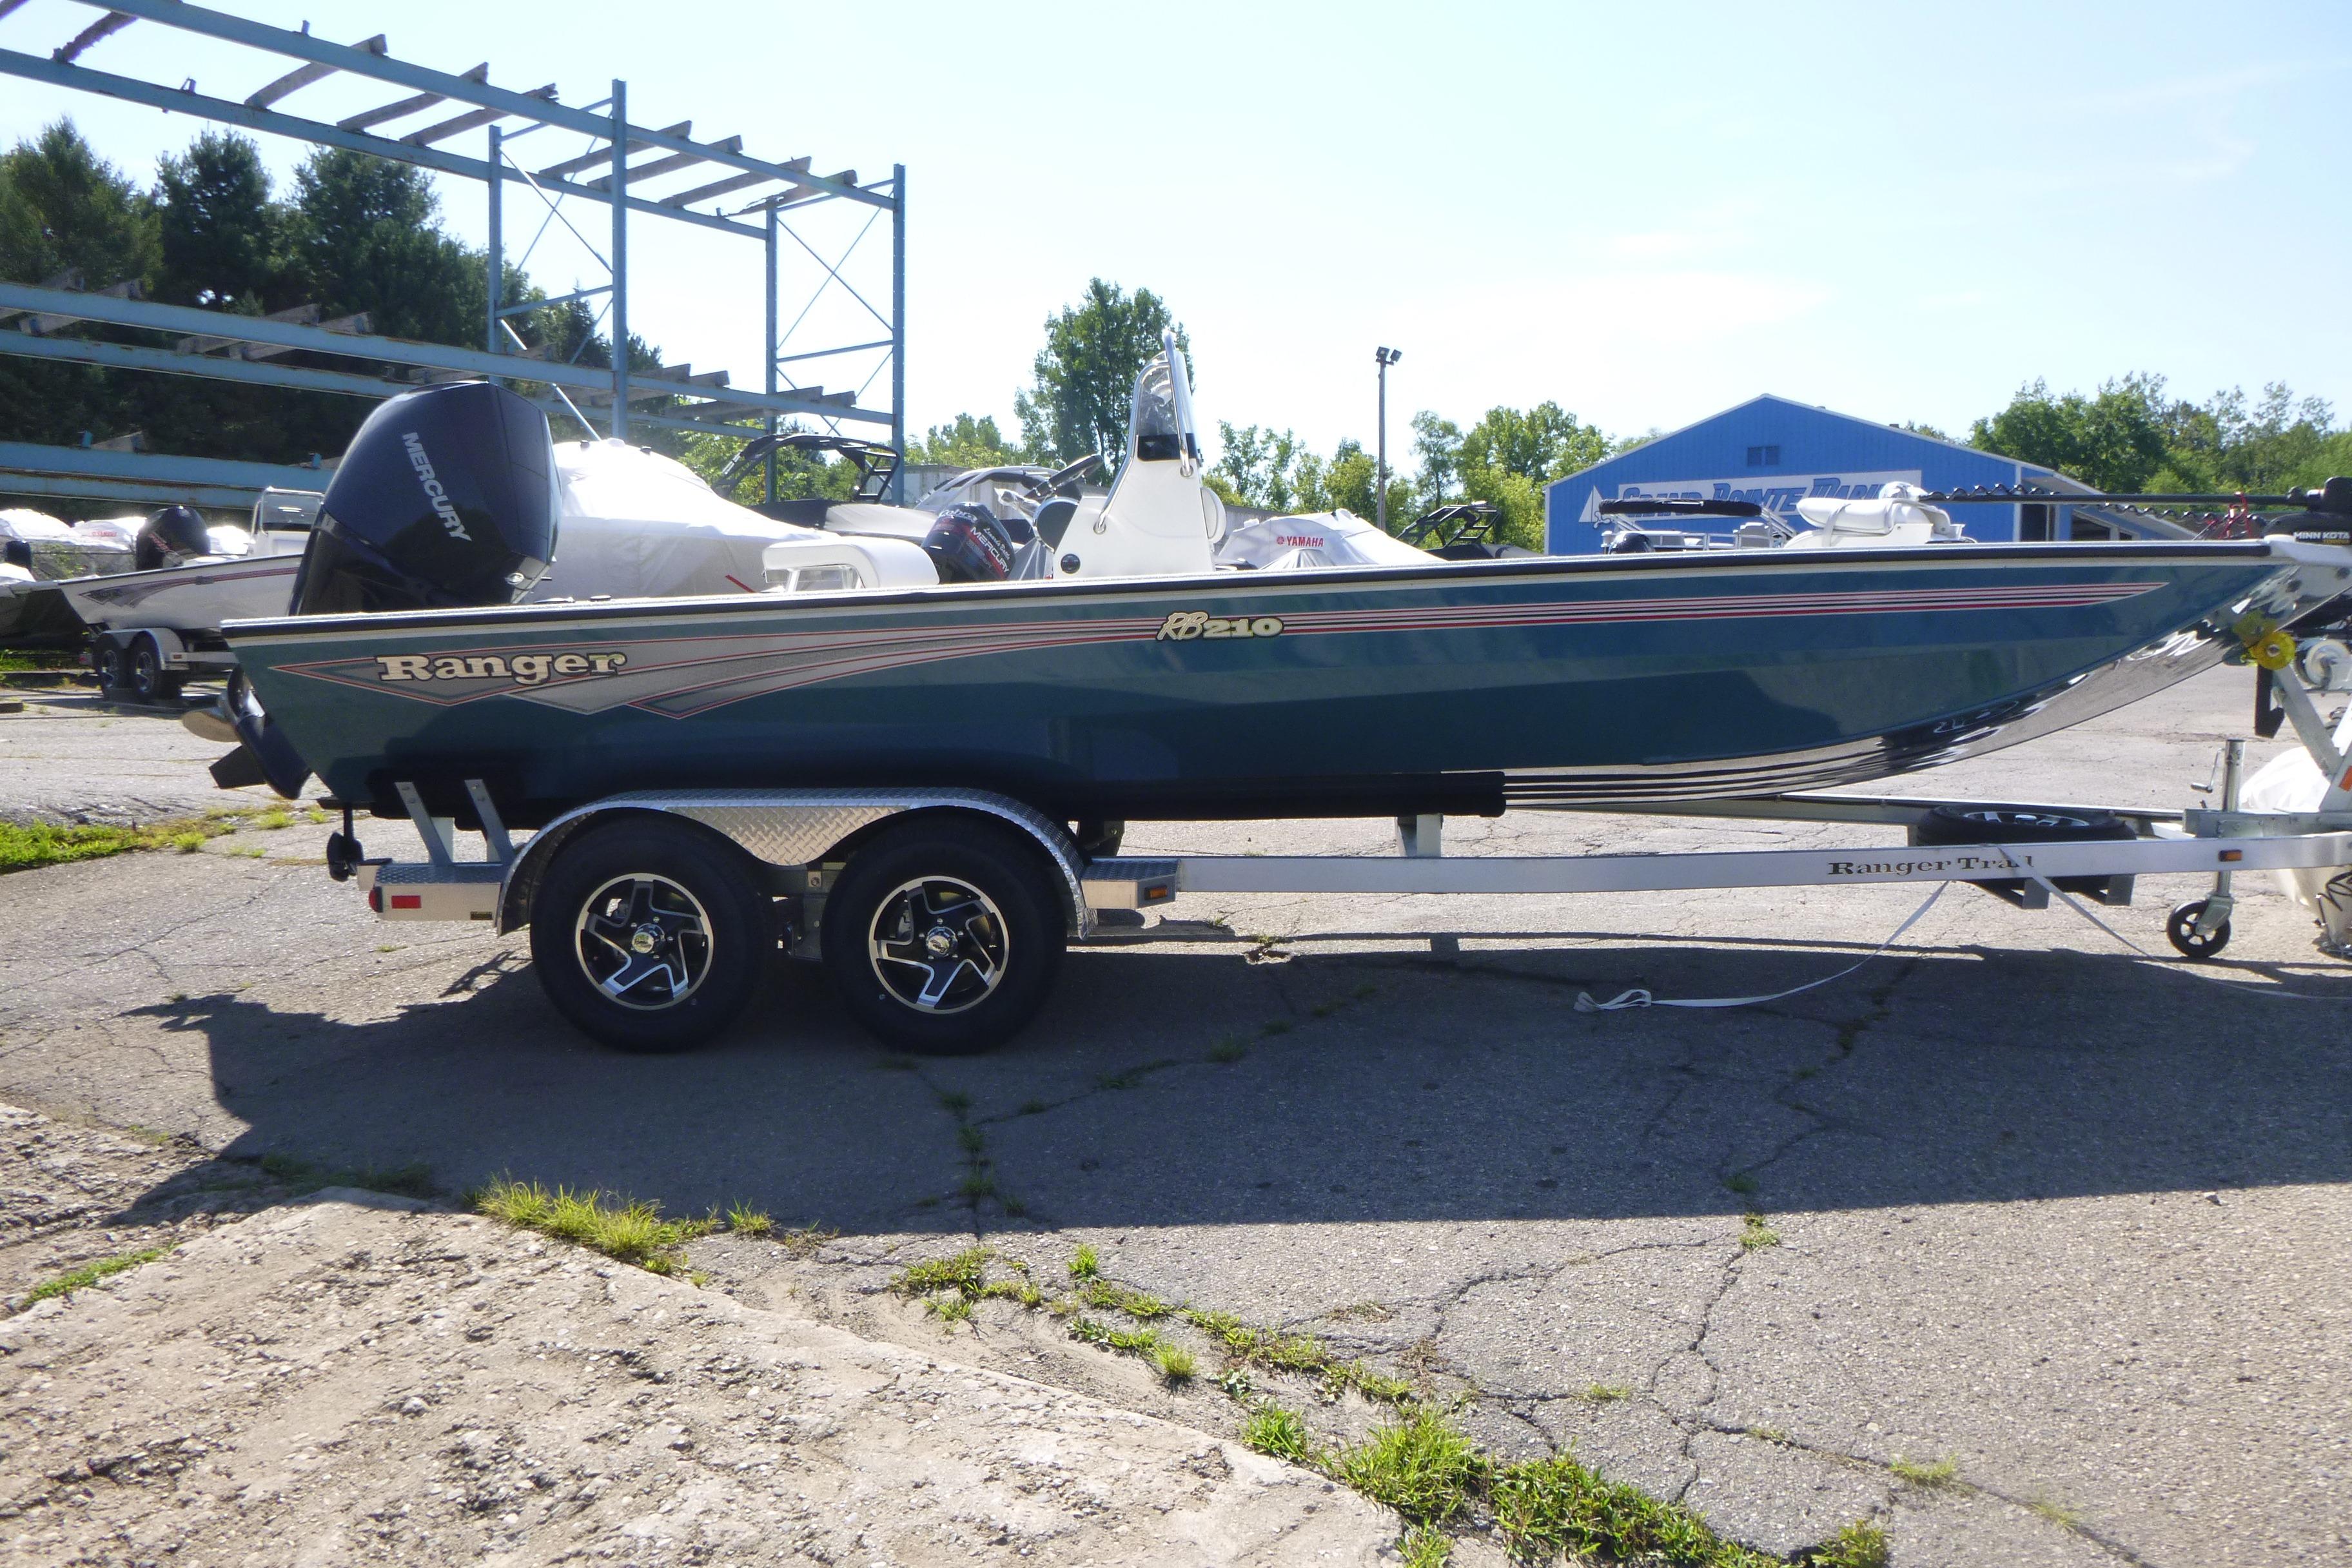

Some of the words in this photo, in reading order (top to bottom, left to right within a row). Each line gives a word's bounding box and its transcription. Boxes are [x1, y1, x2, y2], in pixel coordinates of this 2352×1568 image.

[402, 432, 473, 542] MERCURY
[1808, 478, 1885, 500] MARI
[1287, 536, 1324, 547] YAMAHA
[2293, 531, 2321, 540] MINN
[2322, 531, 2350, 540] KOTA
[970, 527, 1010, 573] MERCURY
[1156, 611, 1284, 641] RB210
[376, 652, 627, 685] Ranger
[1827, 860, 1951, 876] Ranger
[1957, 855, 2035, 870] Tral
